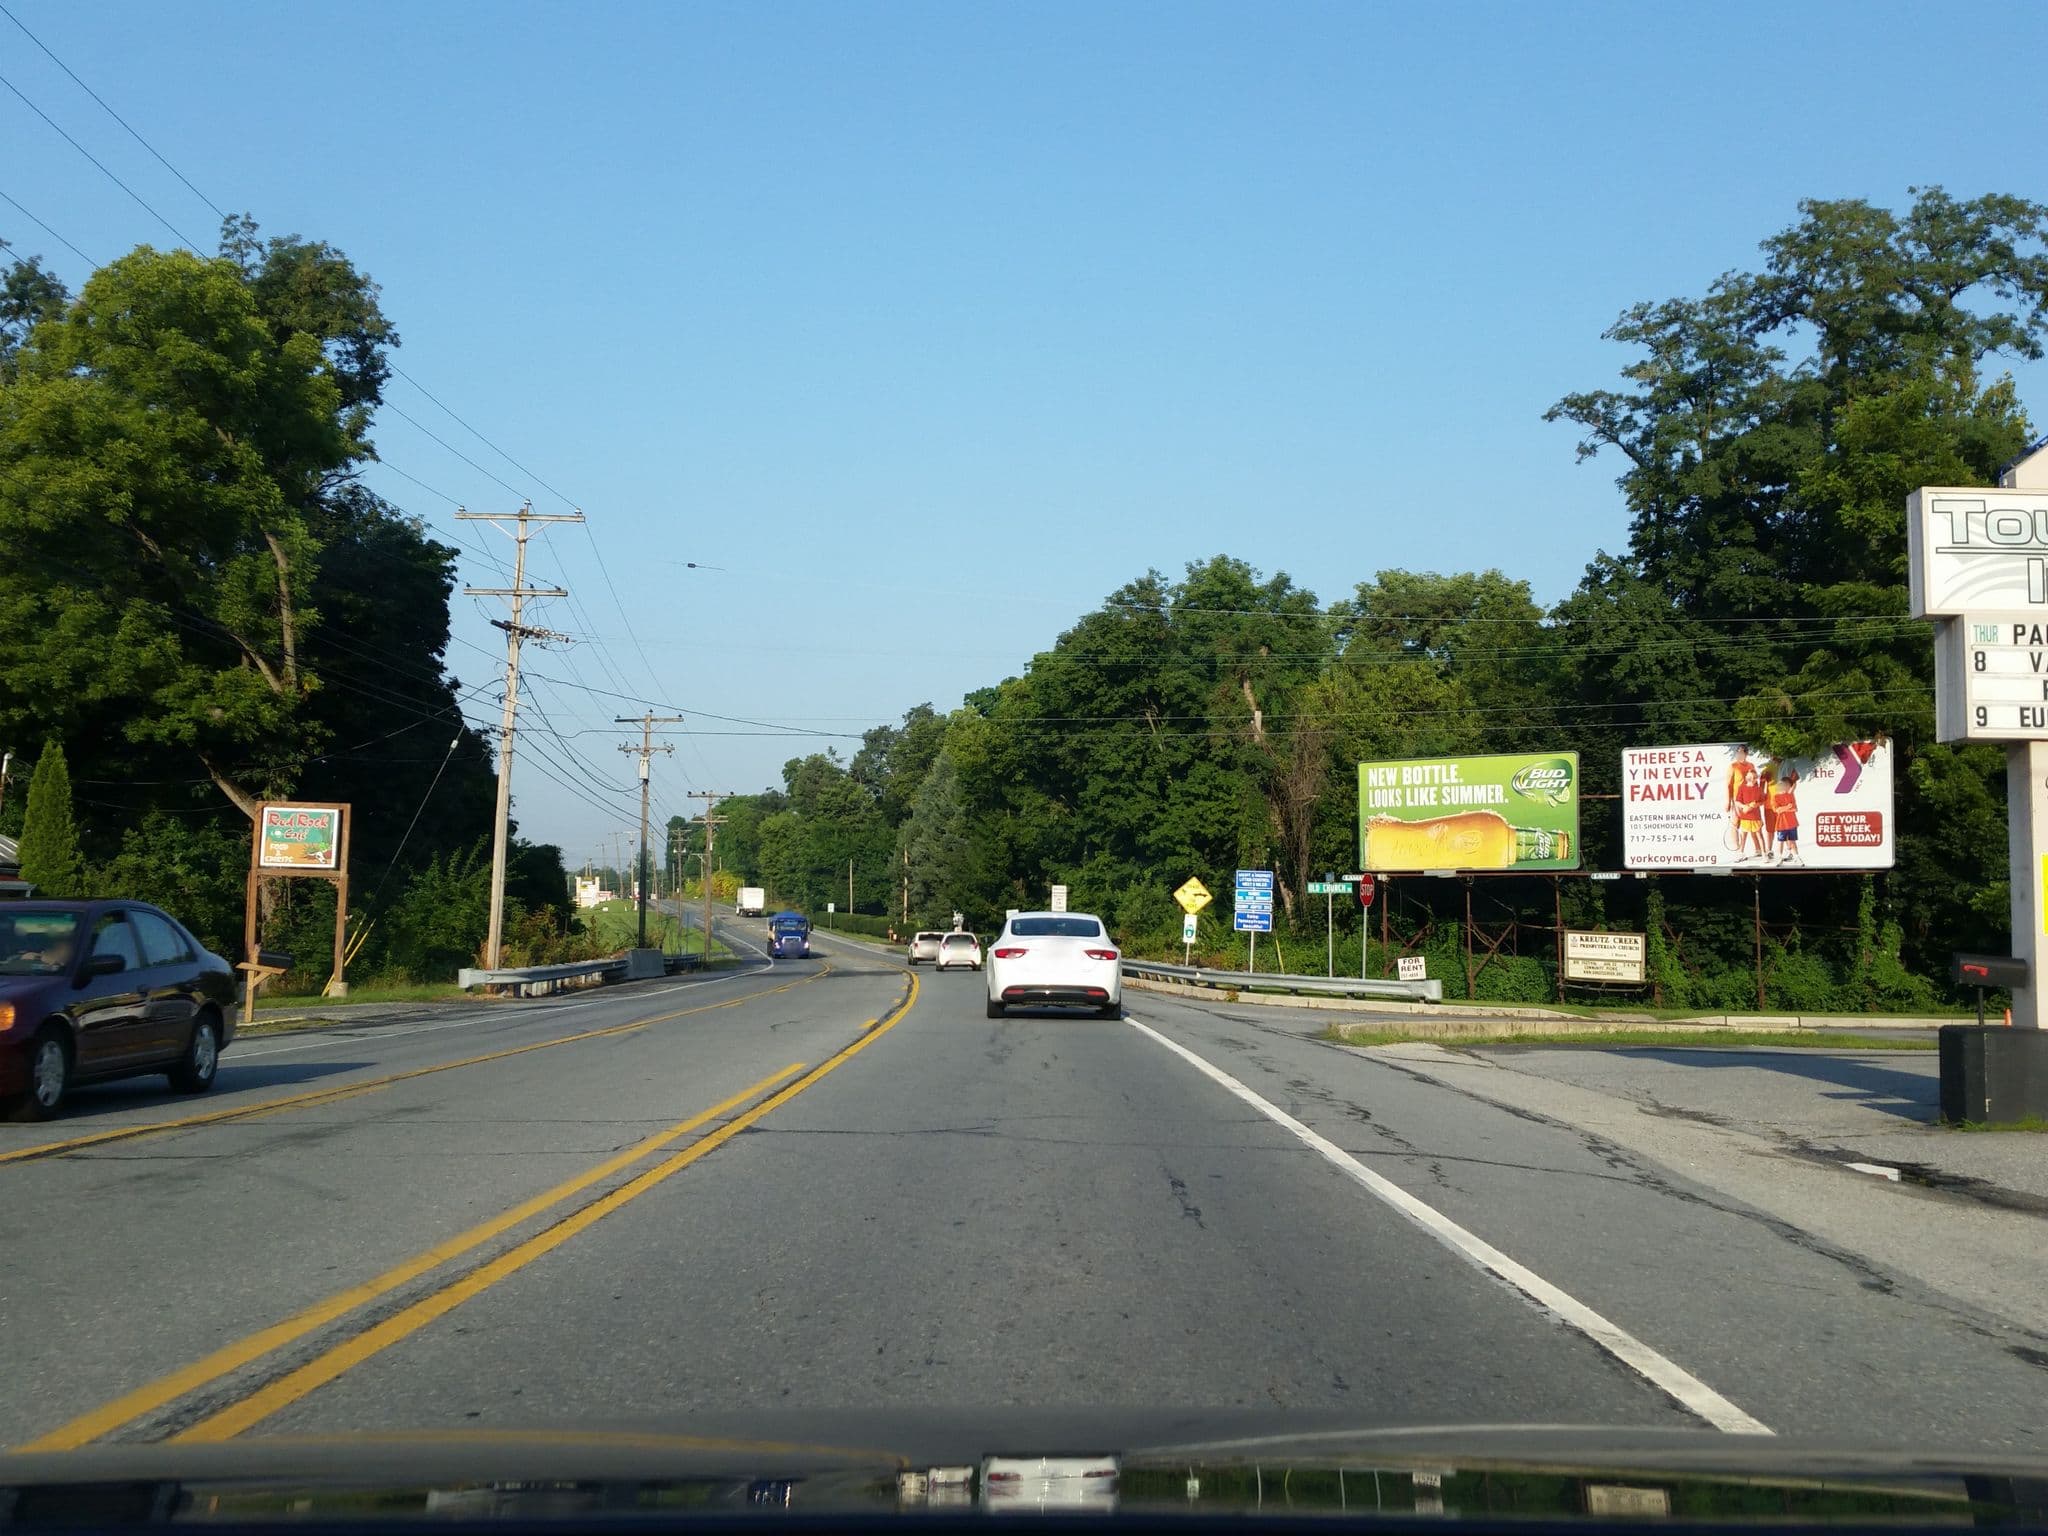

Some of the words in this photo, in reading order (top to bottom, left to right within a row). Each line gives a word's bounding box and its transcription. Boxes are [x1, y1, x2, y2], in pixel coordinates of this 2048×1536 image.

[2027, 557, 2048, 604] I
[1973, 624, 1999, 643] THUR
[1974, 650, 1987, 672] 8
[1976, 706, 1988, 727] 9
[2019, 706, 2048, 728] EU
[1628, 751, 1690, 766] THERE'S
[1695, 750, 1706, 763] A
[1368, 768, 1397, 787] NEW
[1402, 764, 1464, 785] BOTTLE.
[1529, 768, 1566, 779] BUD
[1629, 769, 1639, 781] Y
[1643, 768, 1660, 780] IN
[1664, 766, 1713, 780] EVERY
[1815, 767, 1835, 779] the
[1522, 779, 1571, 789] LIGHT
[1369, 788, 1402, 808] LOOKS
[1406, 787, 1438, 807] LIKE
[1441, 785, 1509, 805] SUMMER.
[1630, 782, 1709, 802] FAMILY
[268, 813, 295, 827] Red
[296, 813, 328, 828] Rock
[1818, 815, 1836, 825] GET
[1838, 814, 1866, 824] YOUR
[1818, 824, 1841, 834] FREE
[1843, 824, 1871, 833] WEEK
[1818, 834, 1842, 843] PASS
[1844, 833, 1881, 843] TODAY!
[1630, 854, 1717, 864] yorkcoymca.org
[1360, 884, 1374, 897] STOP
[1580, 936, 1610, 944] KREUTZ
[1613, 937, 1639, 945] CREEK
[1403, 957, 1420, 965] FOR
[1401, 964, 1423, 972] RENT
